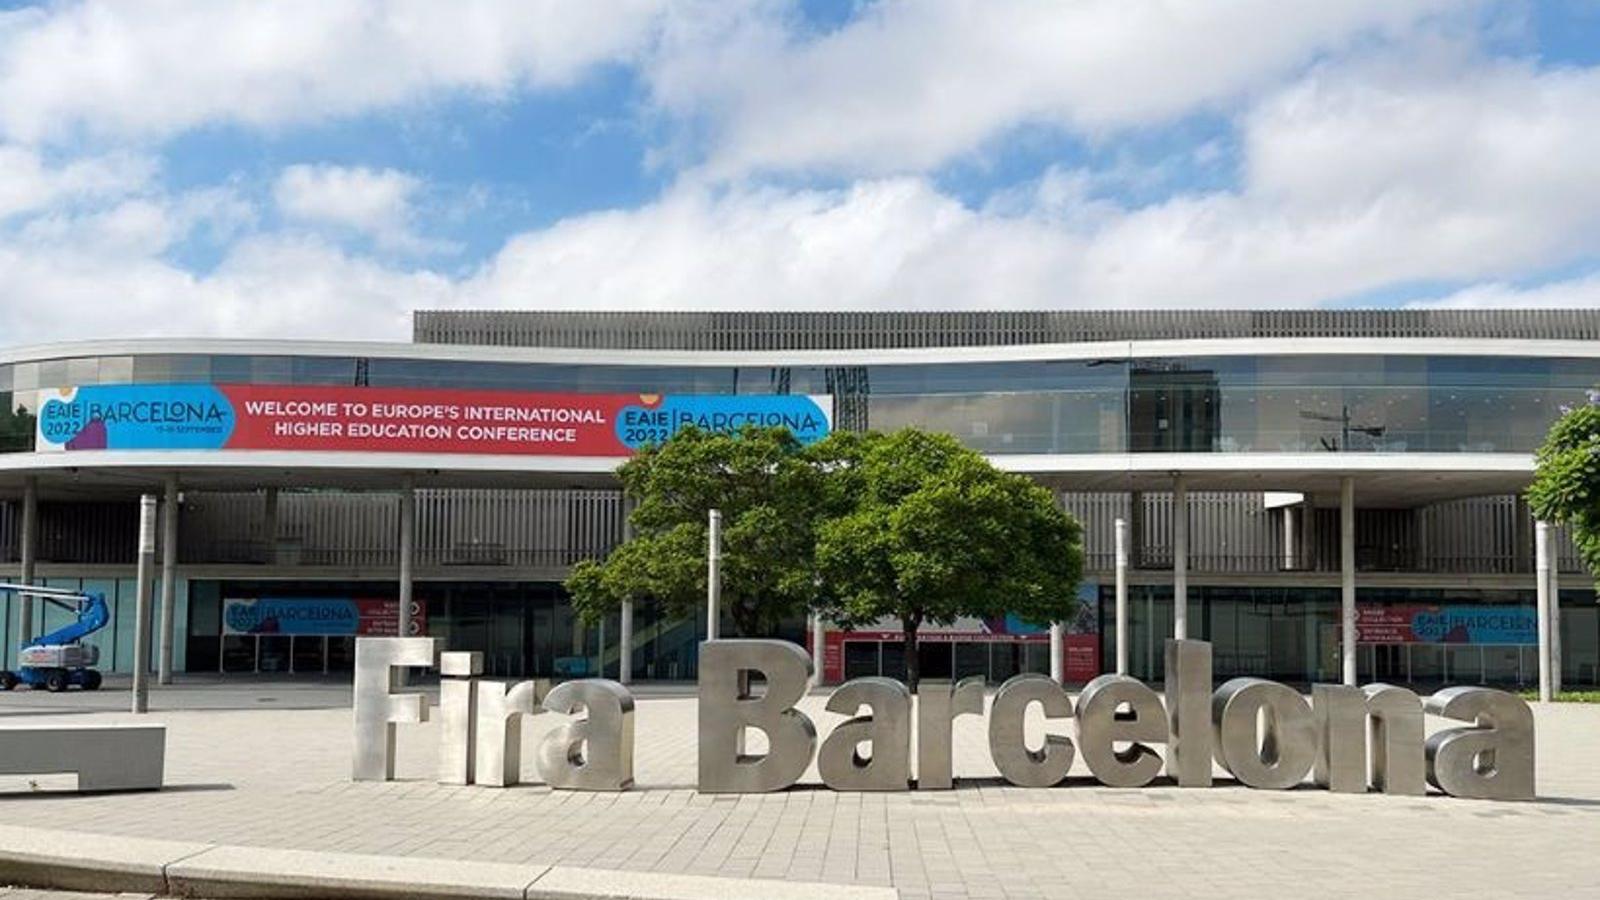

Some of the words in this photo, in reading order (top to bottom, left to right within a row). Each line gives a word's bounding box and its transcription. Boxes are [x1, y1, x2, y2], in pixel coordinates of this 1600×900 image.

[47, 403, 81, 418] EAIE
[90, 402, 227, 423] BARCELONA
[245, 401, 337, 416] WELCOME
[343, 403, 367, 416] TO
[372, 404, 459, 420] EUROPE'S
[464, 406, 606, 423] INTERNATIONAL
[624, 411, 668, 426] EAIE
[47, 422, 81, 436] 2022
[274, 422, 342, 437] HIGHER
[347, 424, 452, 439] EDUCATION
[457, 426, 577, 442] CONFERENCE
[624, 428, 668, 442] 2022
[353, 637, 635, 791] Fira
[698, 638, 1536, 801] Barcelona
